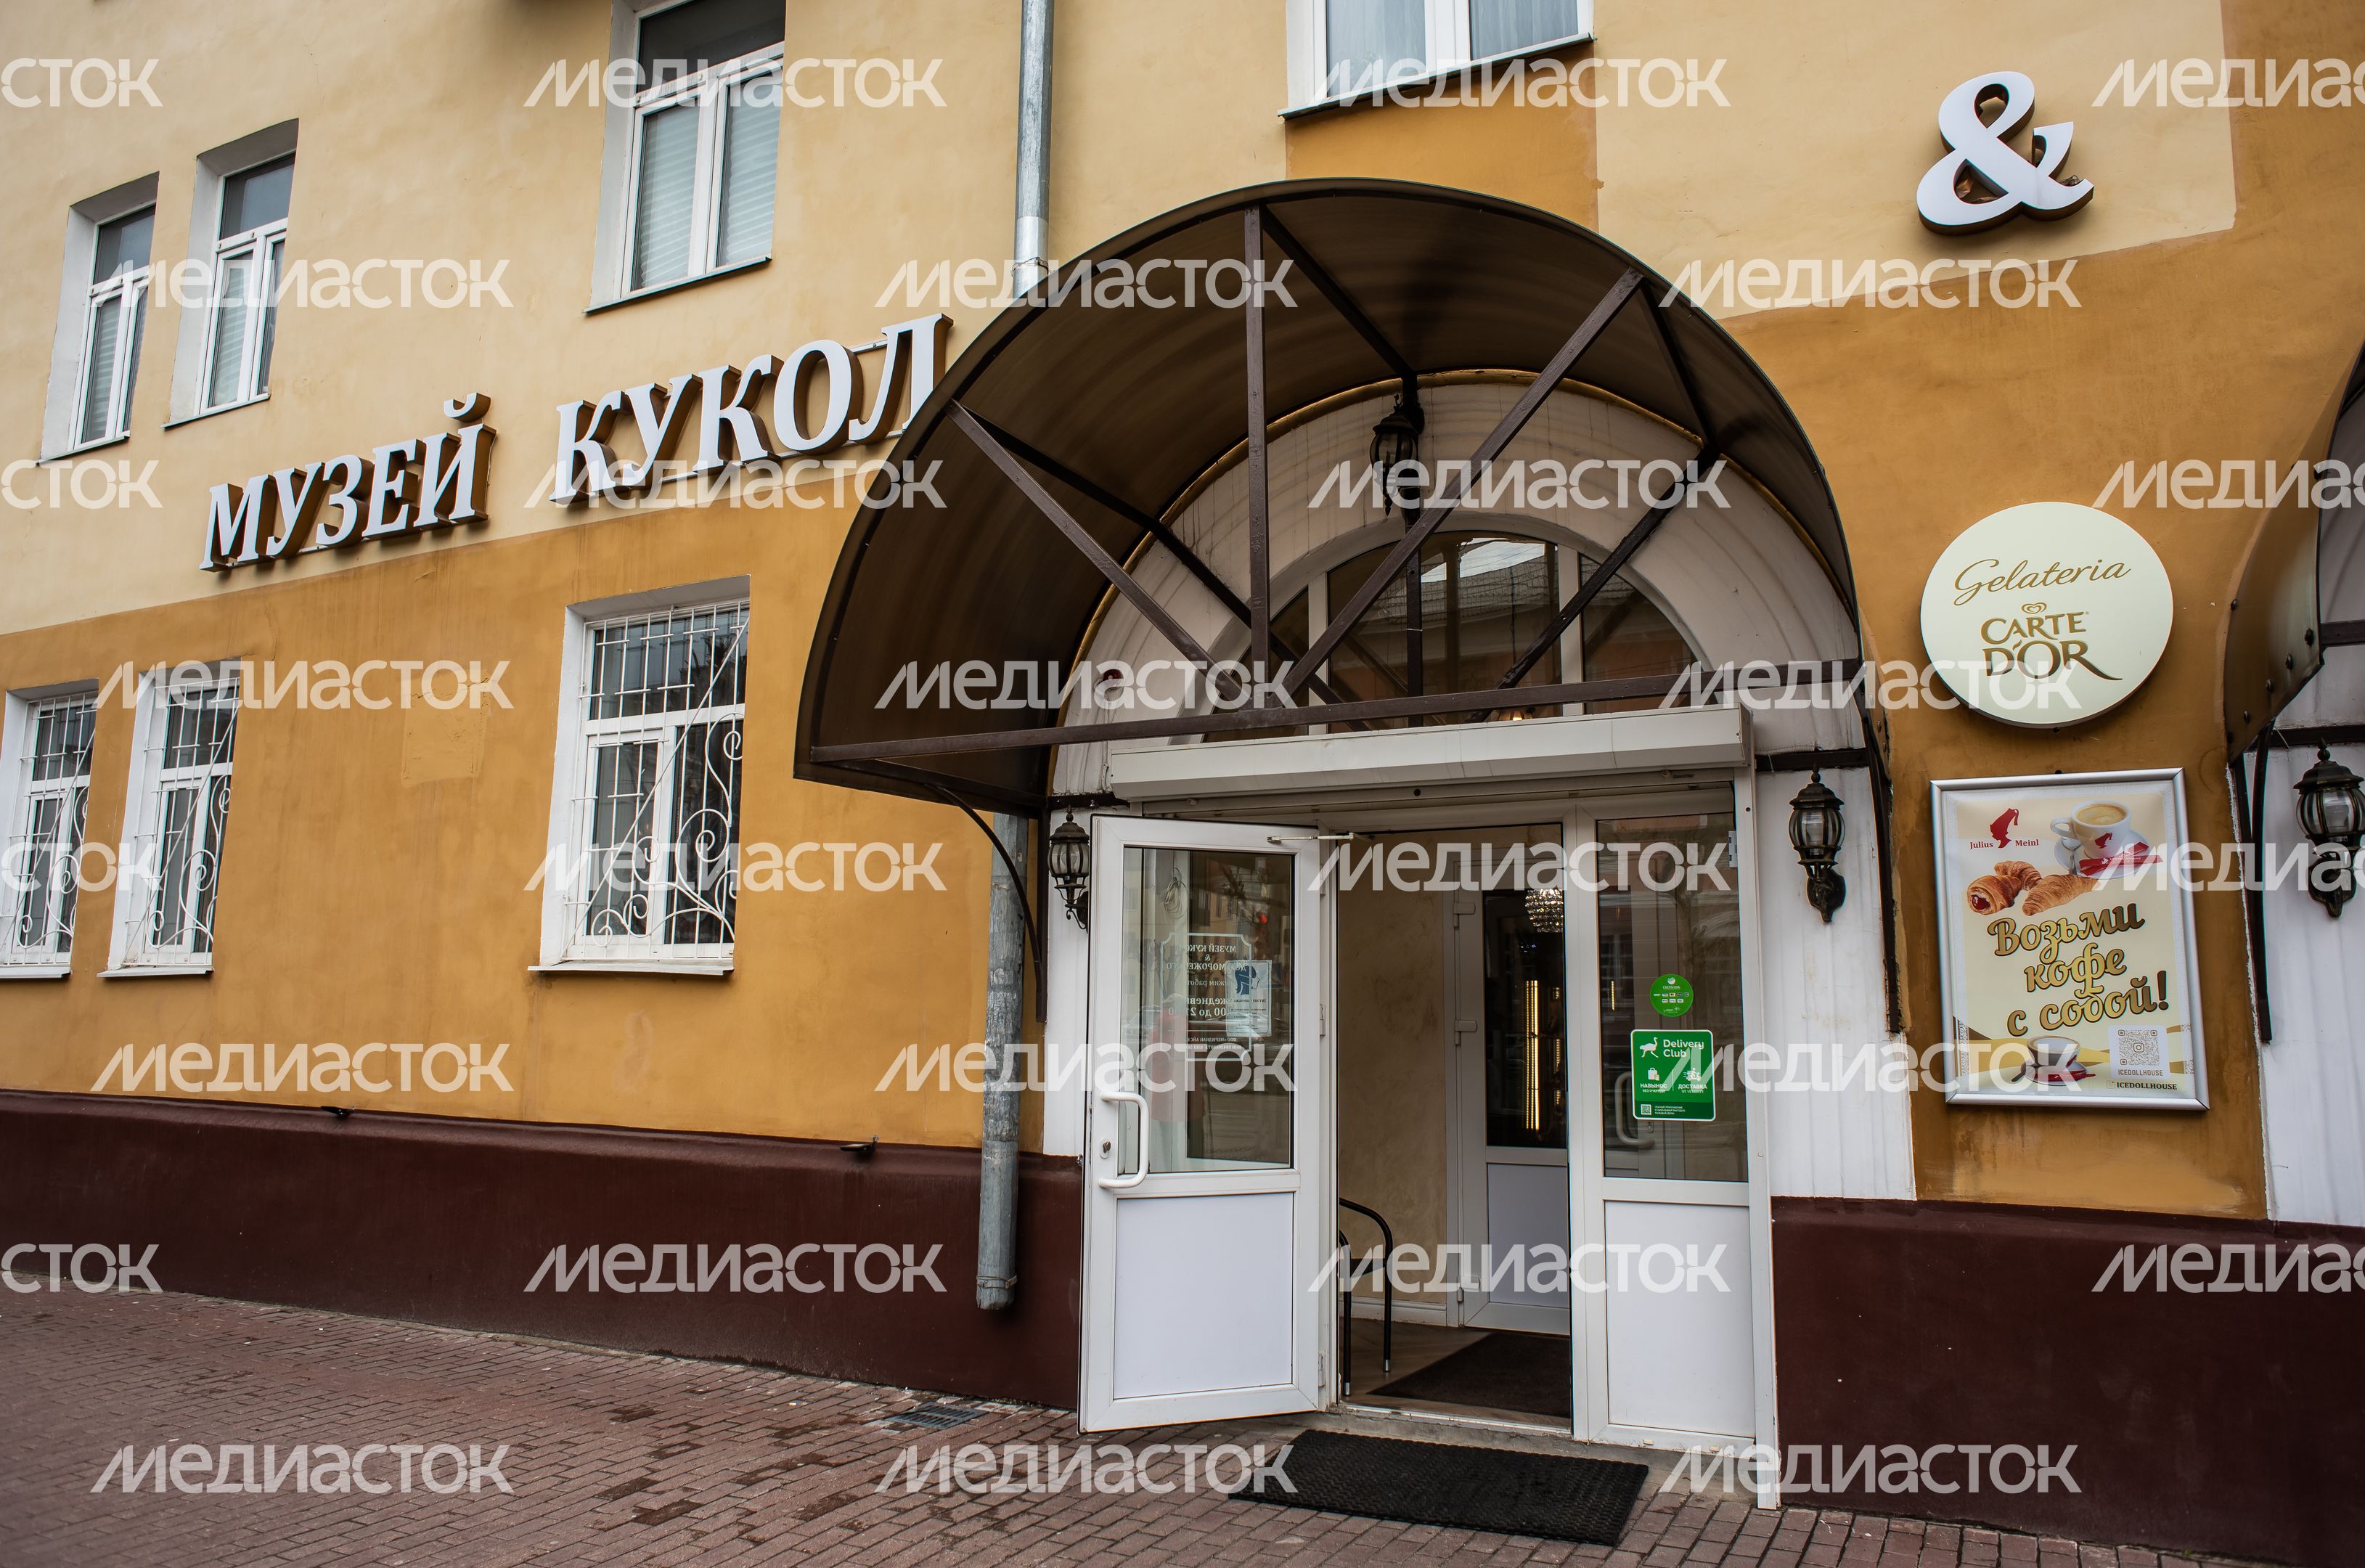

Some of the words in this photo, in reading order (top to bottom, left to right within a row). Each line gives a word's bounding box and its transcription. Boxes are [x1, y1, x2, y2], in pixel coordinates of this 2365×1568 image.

[1916, 71, 2095, 235] &
[199, 392, 498, 572] МУЗЕЙ
[549, 313, 955, 505] КУКОЛ
[1953, 558, 2132, 606] Gelateria
[1980, 611, 2087, 645] CARTE
[1982, 640, 2123, 681] D'OR
[1969, 841, 1994, 850] Julius
[2014, 838, 2040, 847] Meinl
[1987, 903, 2145, 964] Возьми
[2024, 943, 2128, 997] кофе
[2007, 1009, 2028, 1037] с
[2039, 971, 2169, 1031] собой!
[1663, 1039, 1704, 1049] Delivery
[1663, 1049, 1687, 1058] Club
[2116, 1082, 2178, 1090] ICEDOLLHOUSE
